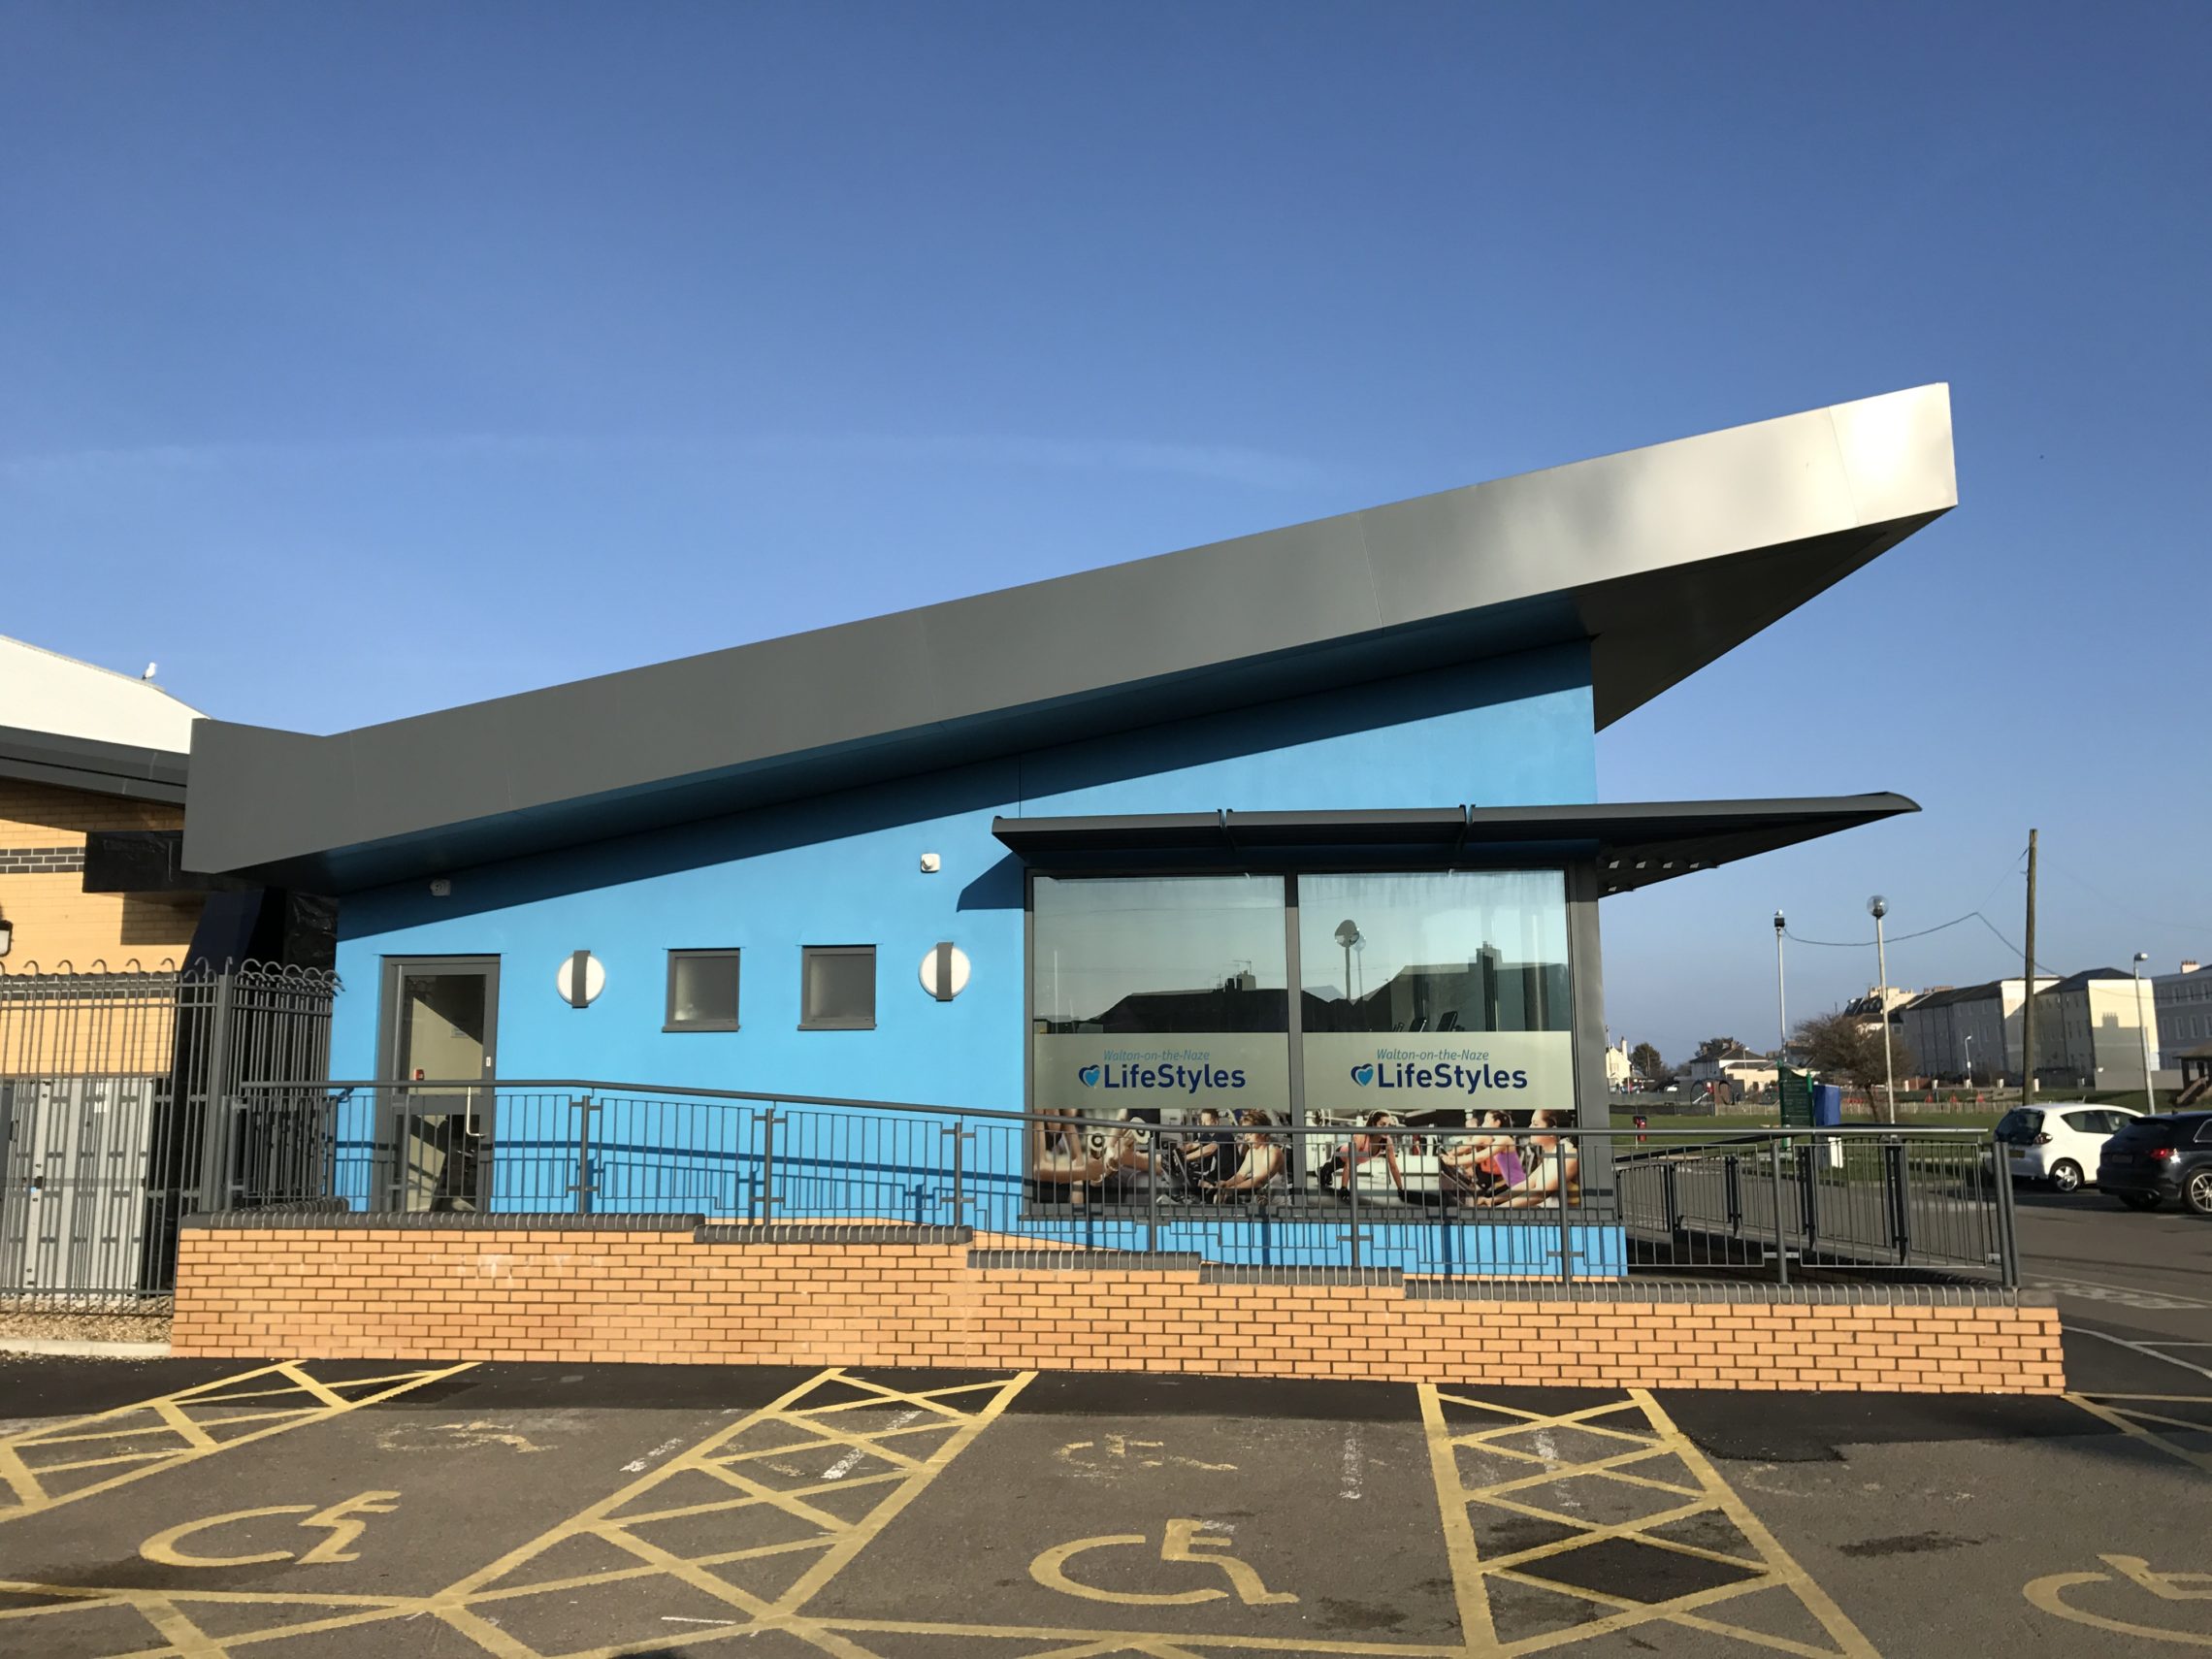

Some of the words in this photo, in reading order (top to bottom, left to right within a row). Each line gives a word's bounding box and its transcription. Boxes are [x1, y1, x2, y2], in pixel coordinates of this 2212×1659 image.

[1103, 1050, 1211, 1061] Walton-on-the-Naze
[1377, 1049, 1489, 1060] Walton-on-the-Naze
[1104, 1063, 1246, 1094] LifeStyles
[1378, 1063, 1528, 1094] LifeStyles
